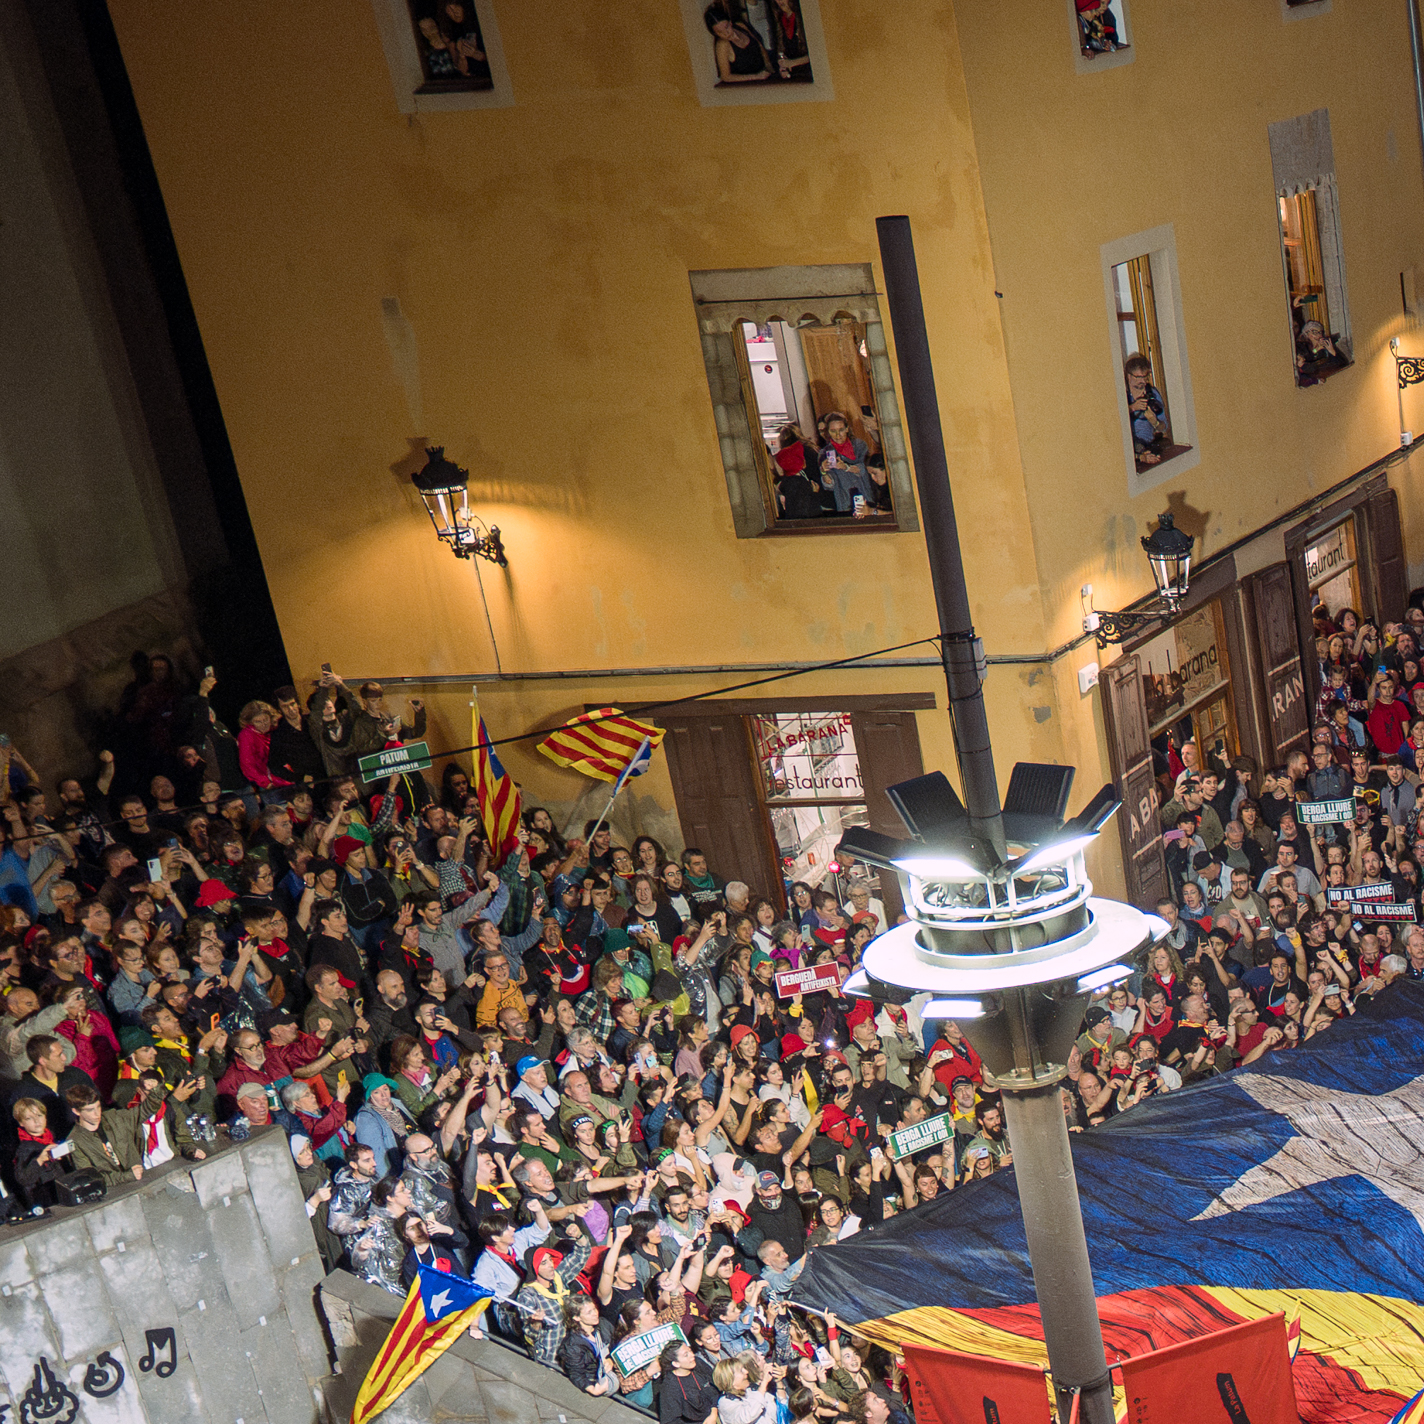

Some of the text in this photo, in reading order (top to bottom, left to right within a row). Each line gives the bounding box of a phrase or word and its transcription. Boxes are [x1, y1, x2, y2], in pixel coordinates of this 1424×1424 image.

[1306, 542, 1345, 580] taurant
[785, 722, 848, 748] BARANA
[769, 762, 864, 791] restaurant
[1301, 801, 1351, 814] BERGA LLIURE
[1312, 813, 1338, 821] RACISME
[1343, 811, 1353, 819] ODI
[1330, 884, 1392, 900] NO AL RACISME
[1352, 903, 1413, 915] NO AL RACISME
[800, 976, 836, 991] ANTIFEIXISTA
[895, 1118, 946, 1143] BERGA LLIURE
[898, 1144, 908, 1155] DE
[908, 1134, 934, 1151] RACISME
[937, 1129, 948, 1139] ODI
